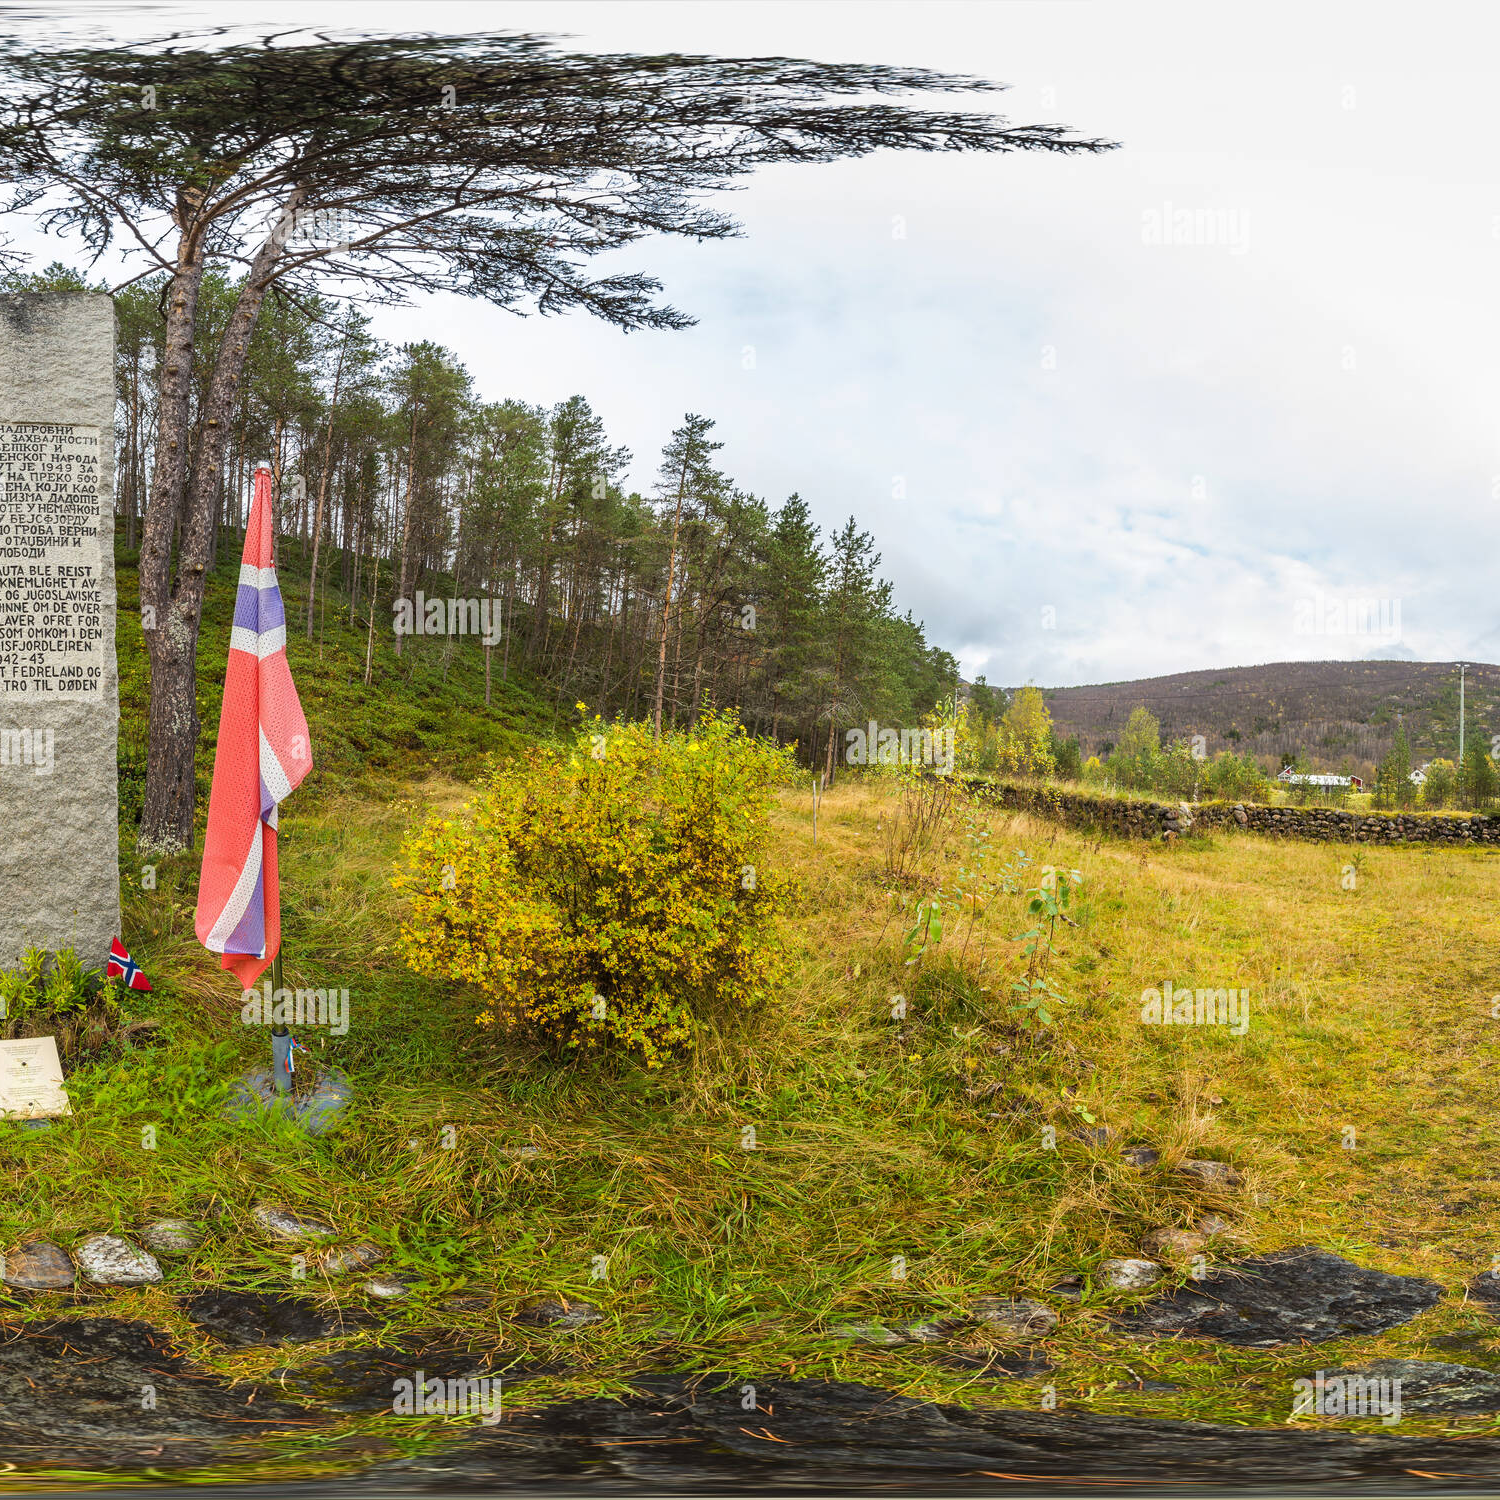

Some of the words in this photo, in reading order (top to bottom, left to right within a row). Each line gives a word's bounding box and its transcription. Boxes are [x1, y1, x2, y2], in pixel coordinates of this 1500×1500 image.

[11, 434, 98, 445] ЗАХВАЛНОСТИ
[54, 444, 62, 452] И
[51, 453, 98, 464] НАРОДА
[19, 462, 35, 471] ЈЕ
[42, 463, 72, 472] 1949
[80, 464, 94, 473] ЗА
[8, 472, 25, 481] НА
[30, 472, 71, 482] ПРЕКО
[77, 474, 98, 483] 500
[35, 483, 67, 492] КОЈИ
[73, 484, 95, 493] КАО
[38, 504, 100, 515] НЕМАЧКОМ
[15, 525, 53, 535] ГРОБА
[59, 526, 97, 537] ВЕРНИ
[72, 537, 81, 547] И
[29, 565, 52, 576] BLE
[58, 566, 92, 576] REIST
[82, 578, 96, 589] AV
[5, 590, 19, 600] OG
[23, 590, 101, 602] JUGOSLAVISKE
[33, 602, 48, 612] OM
[53, 602, 68, 613] DE
[72, 602, 100, 614] OVER
[43, 615, 72, 626] OFRE
[78, 616, 99, 627] FOR
[0, 628, 22, 639] SOM
[27, 627, 67, 638] OMKOM
[72, 628, 75, 638] I
[80, 628, 102, 639] DEN
[13, 666, 83, 677] FEDRELAND
[87, 666, 101, 677] OG
[3, 680, 27, 691] TRO
[33, 680, 53, 691] TIL
[58, 680, 97, 691] DØDEN
